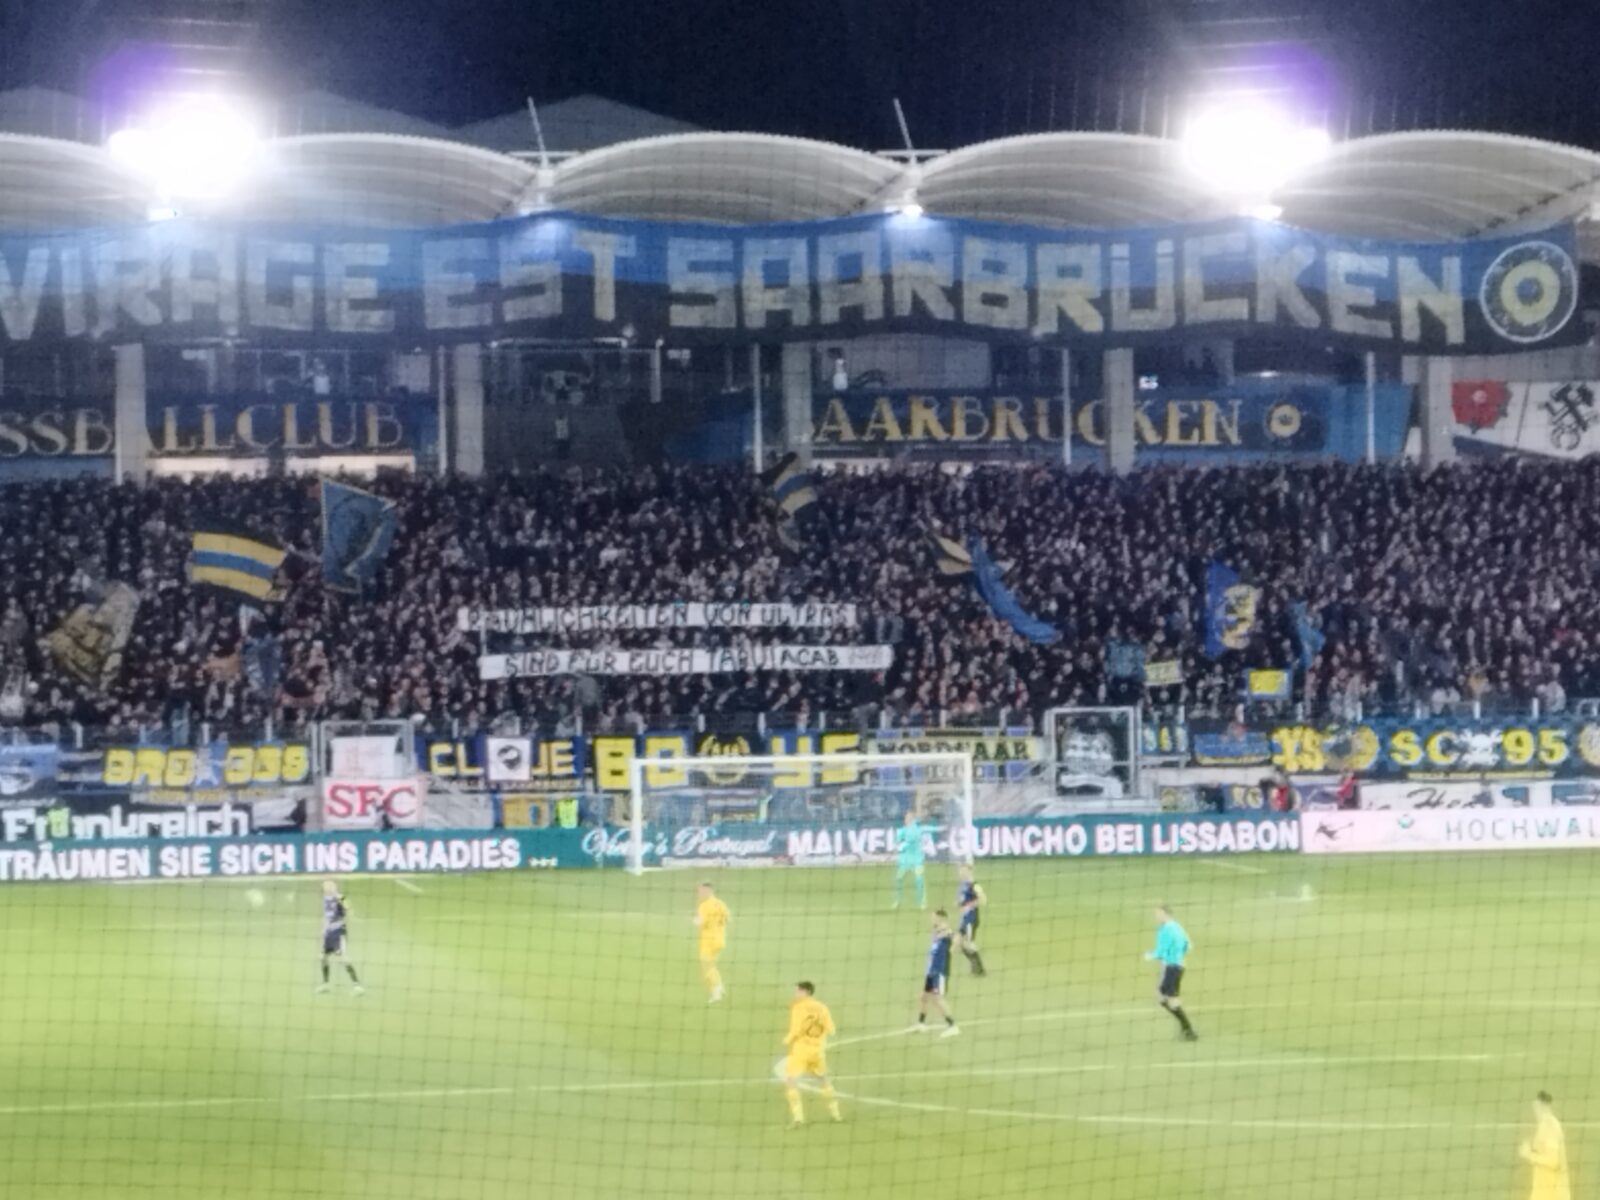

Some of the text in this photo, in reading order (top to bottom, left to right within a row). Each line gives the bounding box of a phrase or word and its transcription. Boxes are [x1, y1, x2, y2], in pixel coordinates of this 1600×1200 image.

[0, 228, 1466, 345] VIRAGE EST SAARBRÜCKEN
[0, 402, 403, 456] SSBLLCLUB
[780, 648, 839, 667] ACAB
[1502, 728, 1570, 765] 95
[326, 782, 418, 819] SFC
[1096, 822, 1143, 853] BEI
[1152, 819, 1299, 853] LISSABON
[0, 842, 151, 881] TRÄUMEN
[160, 842, 212, 877] SIE
[220, 842, 296, 875] SICH
[305, 840, 358, 872] INS
[366, 838, 521, 870] PARADIES
